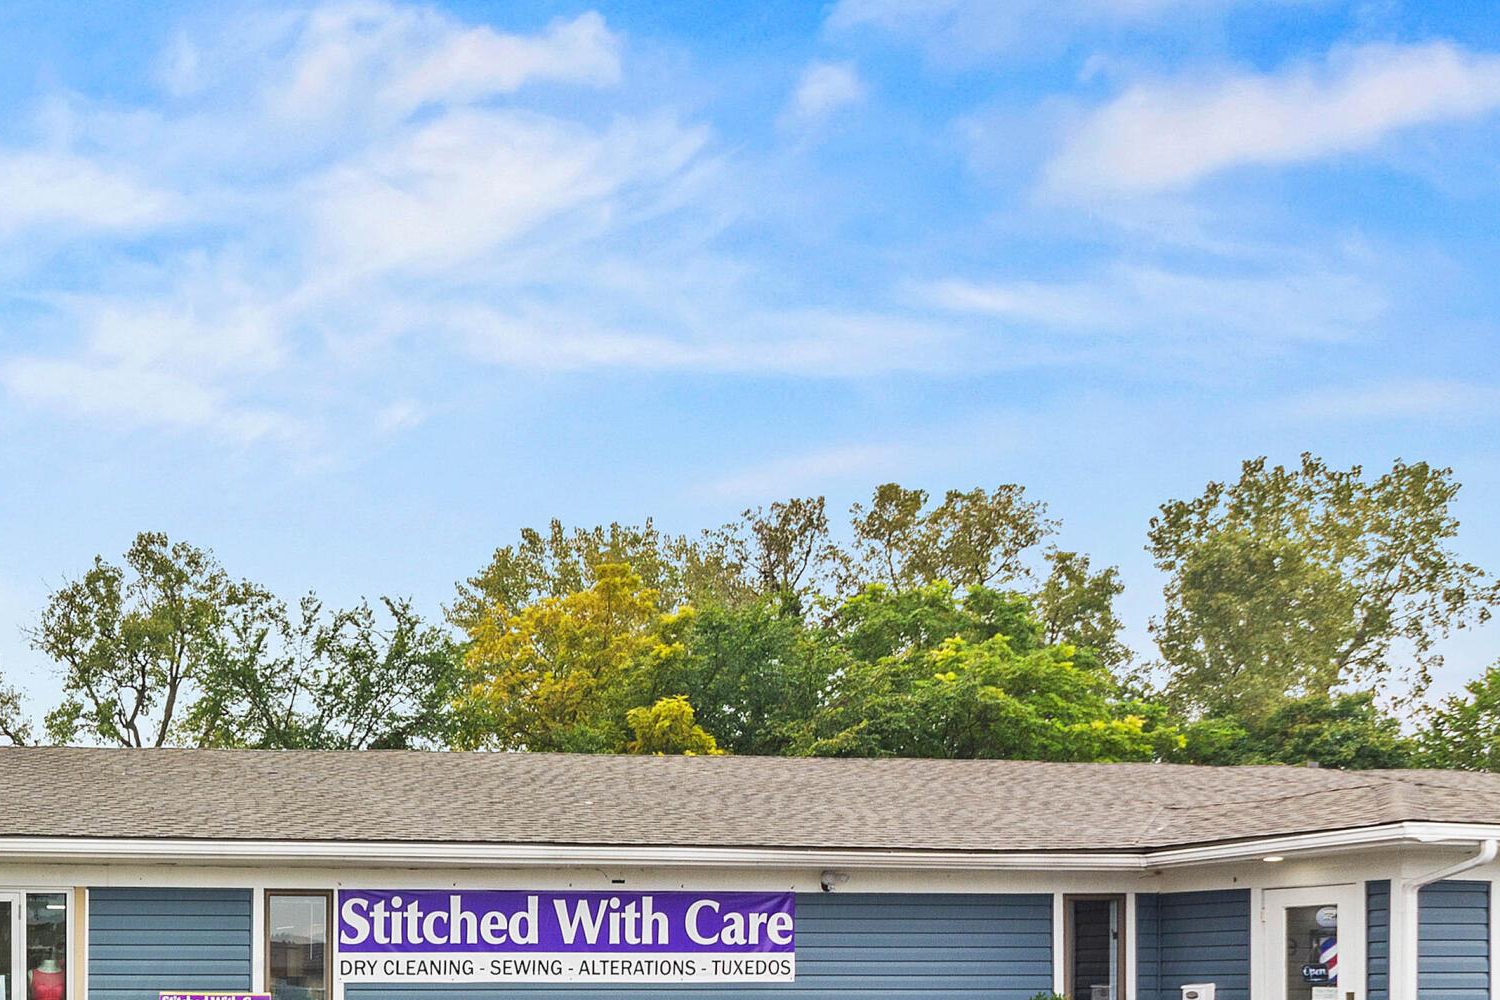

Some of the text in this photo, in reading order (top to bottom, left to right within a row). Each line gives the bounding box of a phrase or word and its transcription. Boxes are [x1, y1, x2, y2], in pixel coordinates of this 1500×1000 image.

[340, 895, 794, 945] Stitched With Care
[340, 960, 378, 976] DRY
[383, 959, 474, 976] CLEANING
[490, 959, 563, 976] SEWING
[578, 959, 696, 976] ALTERATIONS
[712, 959, 791, 976] TUXEDOS
[1303, 966, 1326, 978] Open
